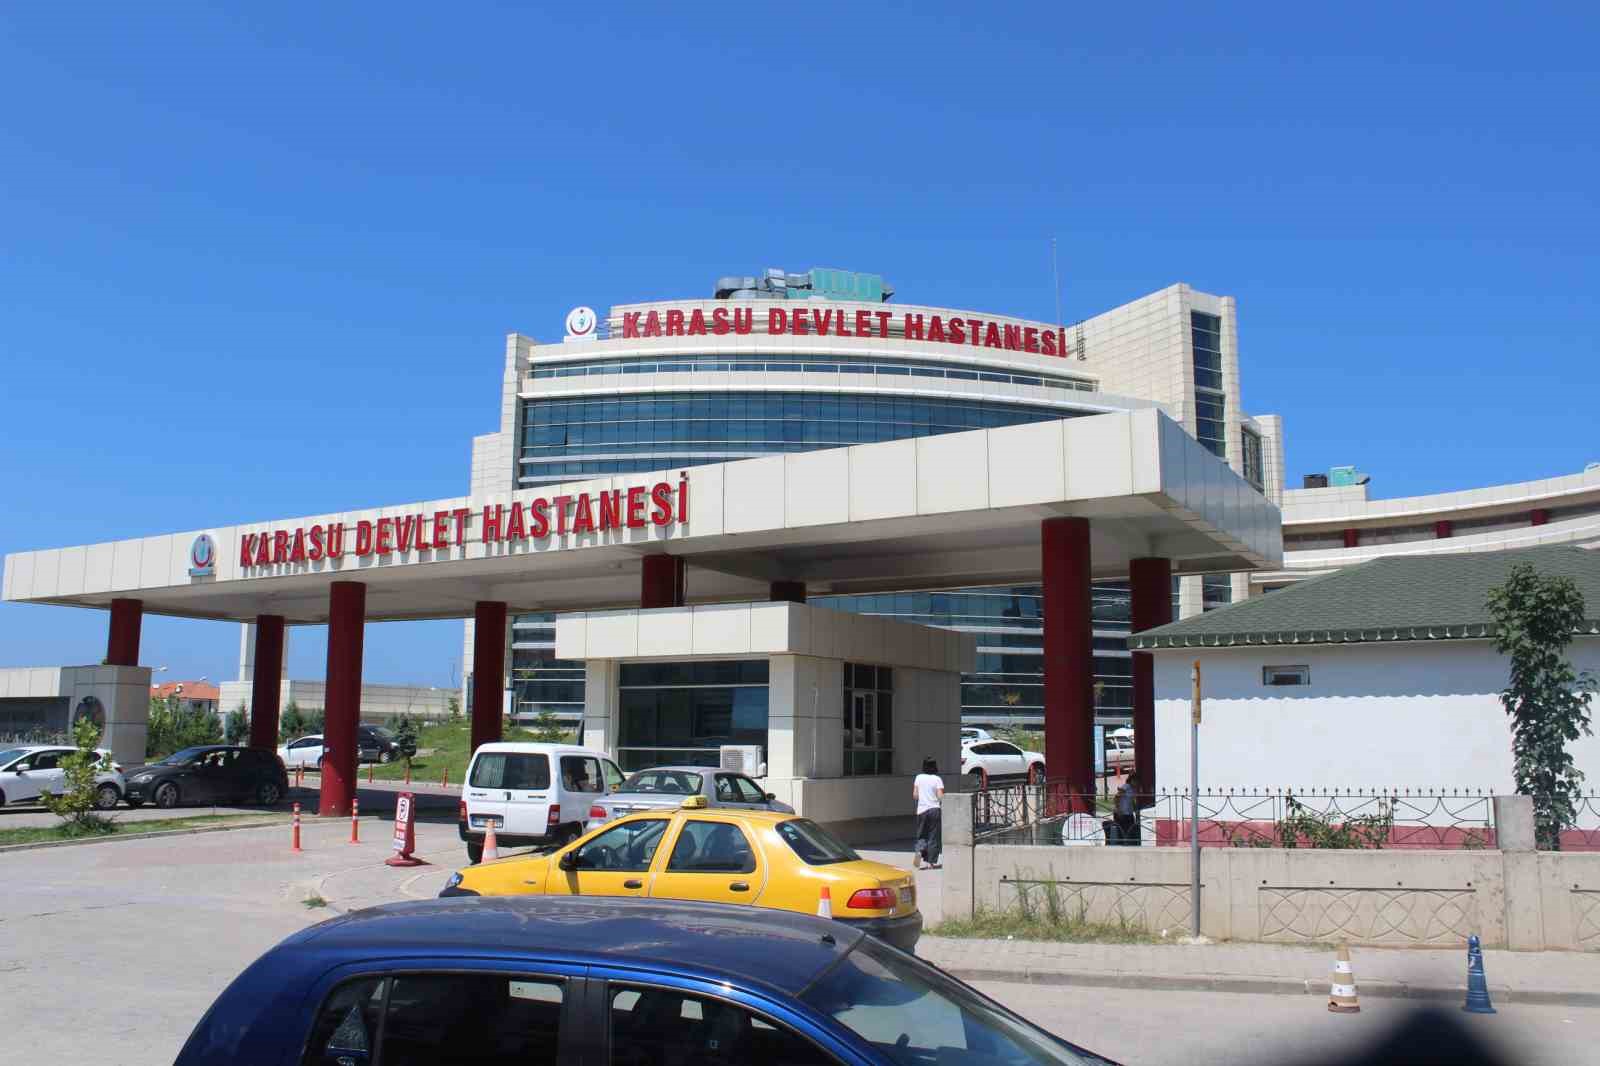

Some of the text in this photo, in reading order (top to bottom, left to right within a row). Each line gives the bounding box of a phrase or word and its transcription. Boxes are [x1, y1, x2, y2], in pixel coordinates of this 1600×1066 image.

[623, 308, 1067, 357] KARASU DEVLET HASTANESİ
[240, 472, 689, 566] KARASU DEVLET HASTANESİ
